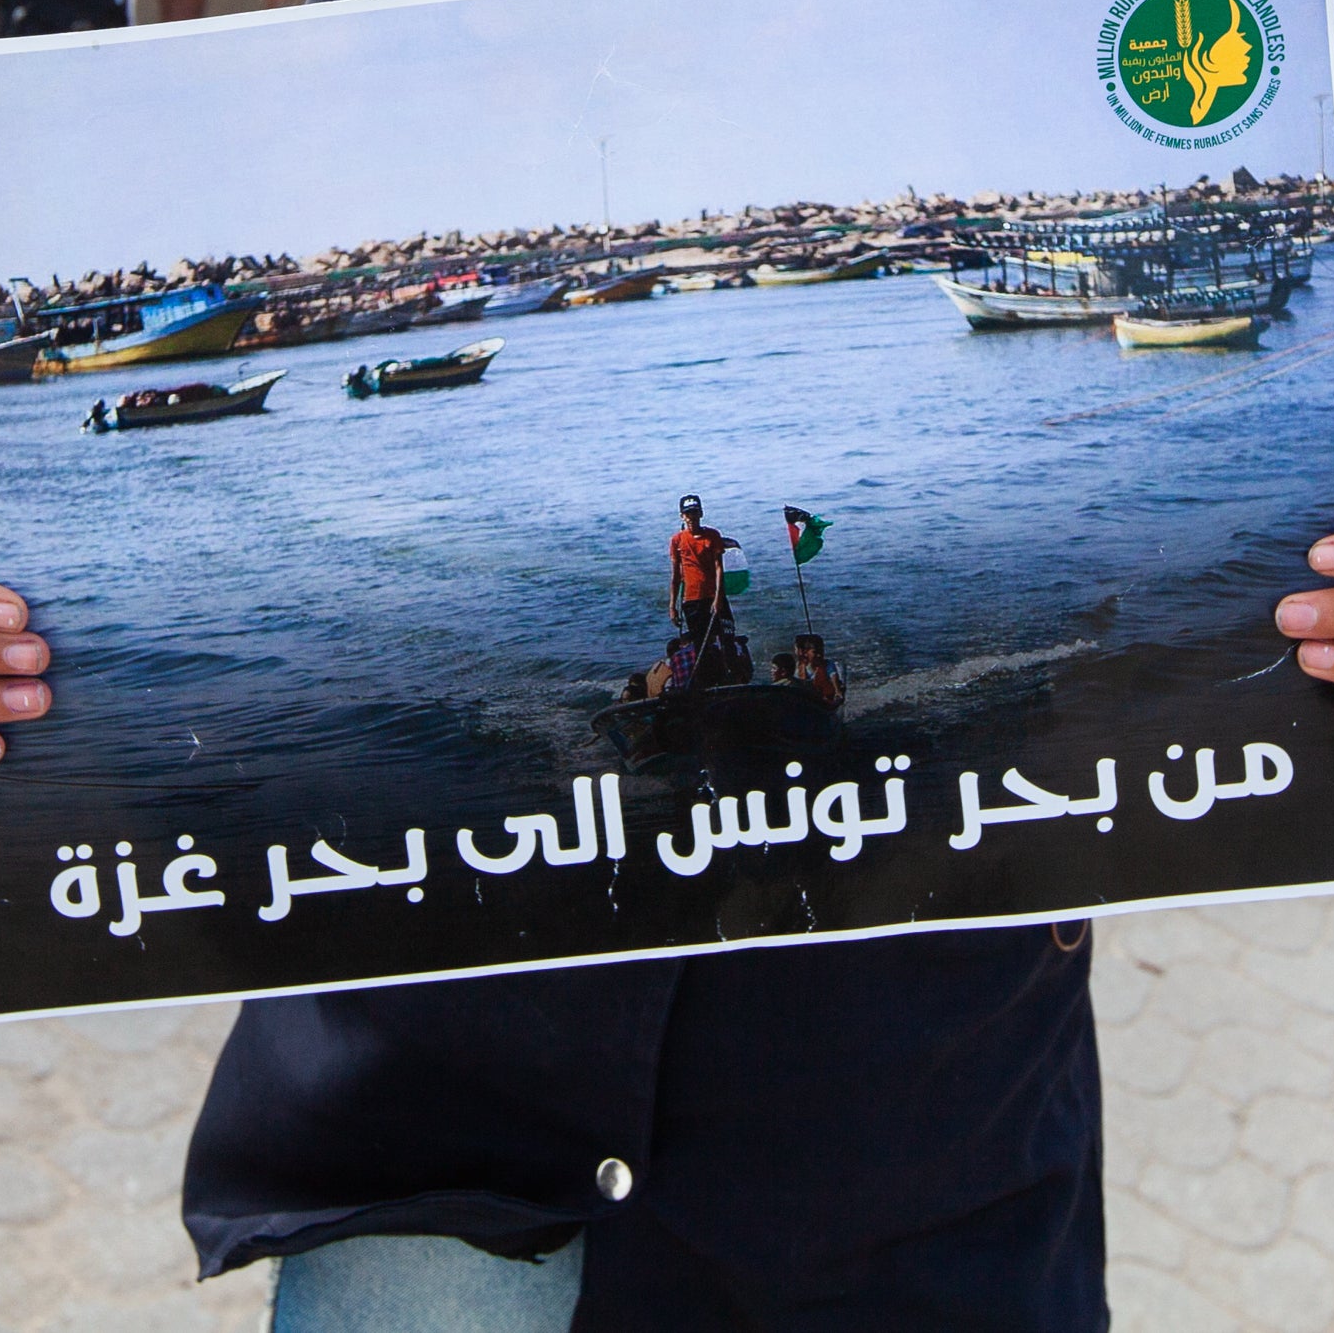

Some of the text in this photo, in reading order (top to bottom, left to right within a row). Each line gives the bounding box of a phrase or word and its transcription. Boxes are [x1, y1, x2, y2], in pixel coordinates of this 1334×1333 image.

[1096, 18, 1121, 80] MILLION
[1128, 38, 1168, 53] جمعية
[1132, 64, 1181, 85] والبدون
[1106, 77, 1281, 150] UN MILLION DE FEMMES RURALES ET SANS TERRES
[50, 743, 1294, 937] من بحر تونس الى بحر غزة
